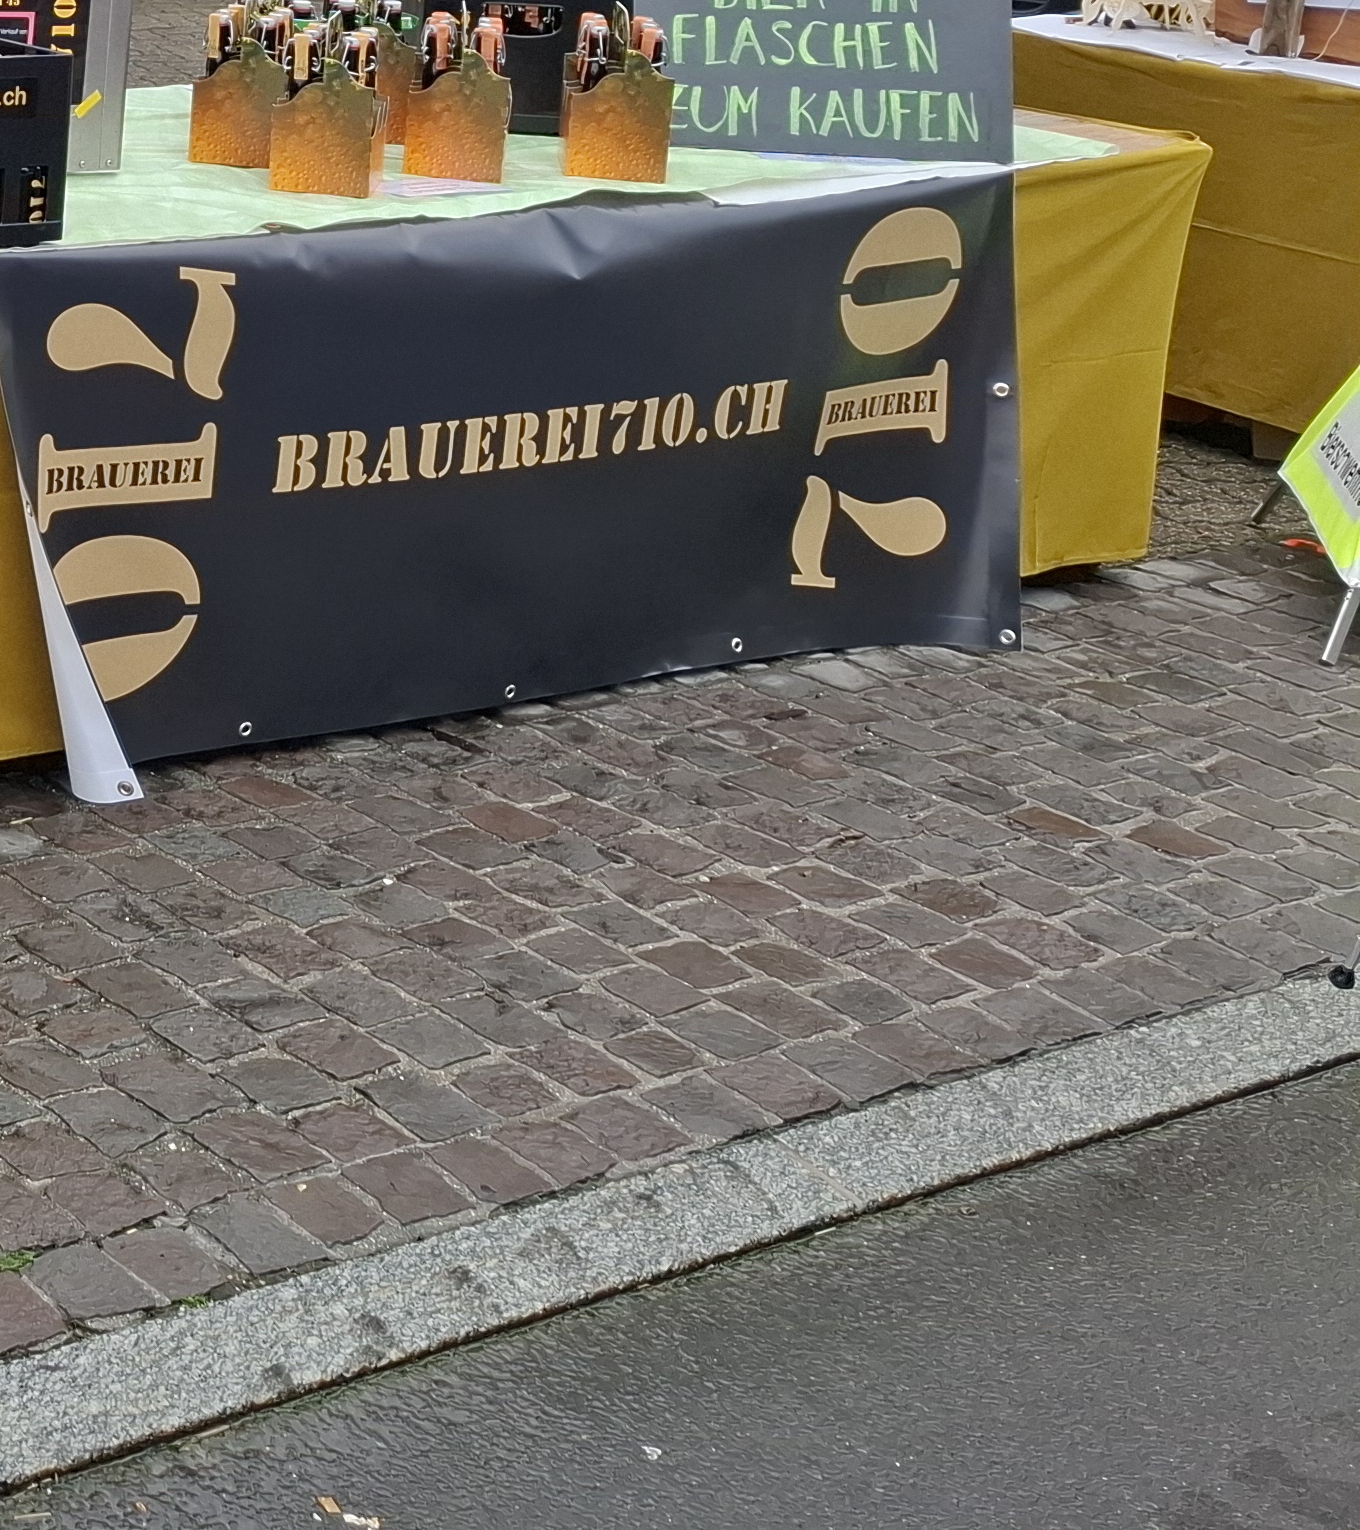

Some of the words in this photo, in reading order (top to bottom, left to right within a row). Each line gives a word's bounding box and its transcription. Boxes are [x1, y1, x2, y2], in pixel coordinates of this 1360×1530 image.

[671, 13, 939, 75] FLASCHEN
[789, 85, 980, 144] KAUFEN
[271, 379, 790, 494] BRAUEREI710.CH
[825, 388, 940, 426] BRAUEREI
[45, 455, 204, 497] BRAUEREI
